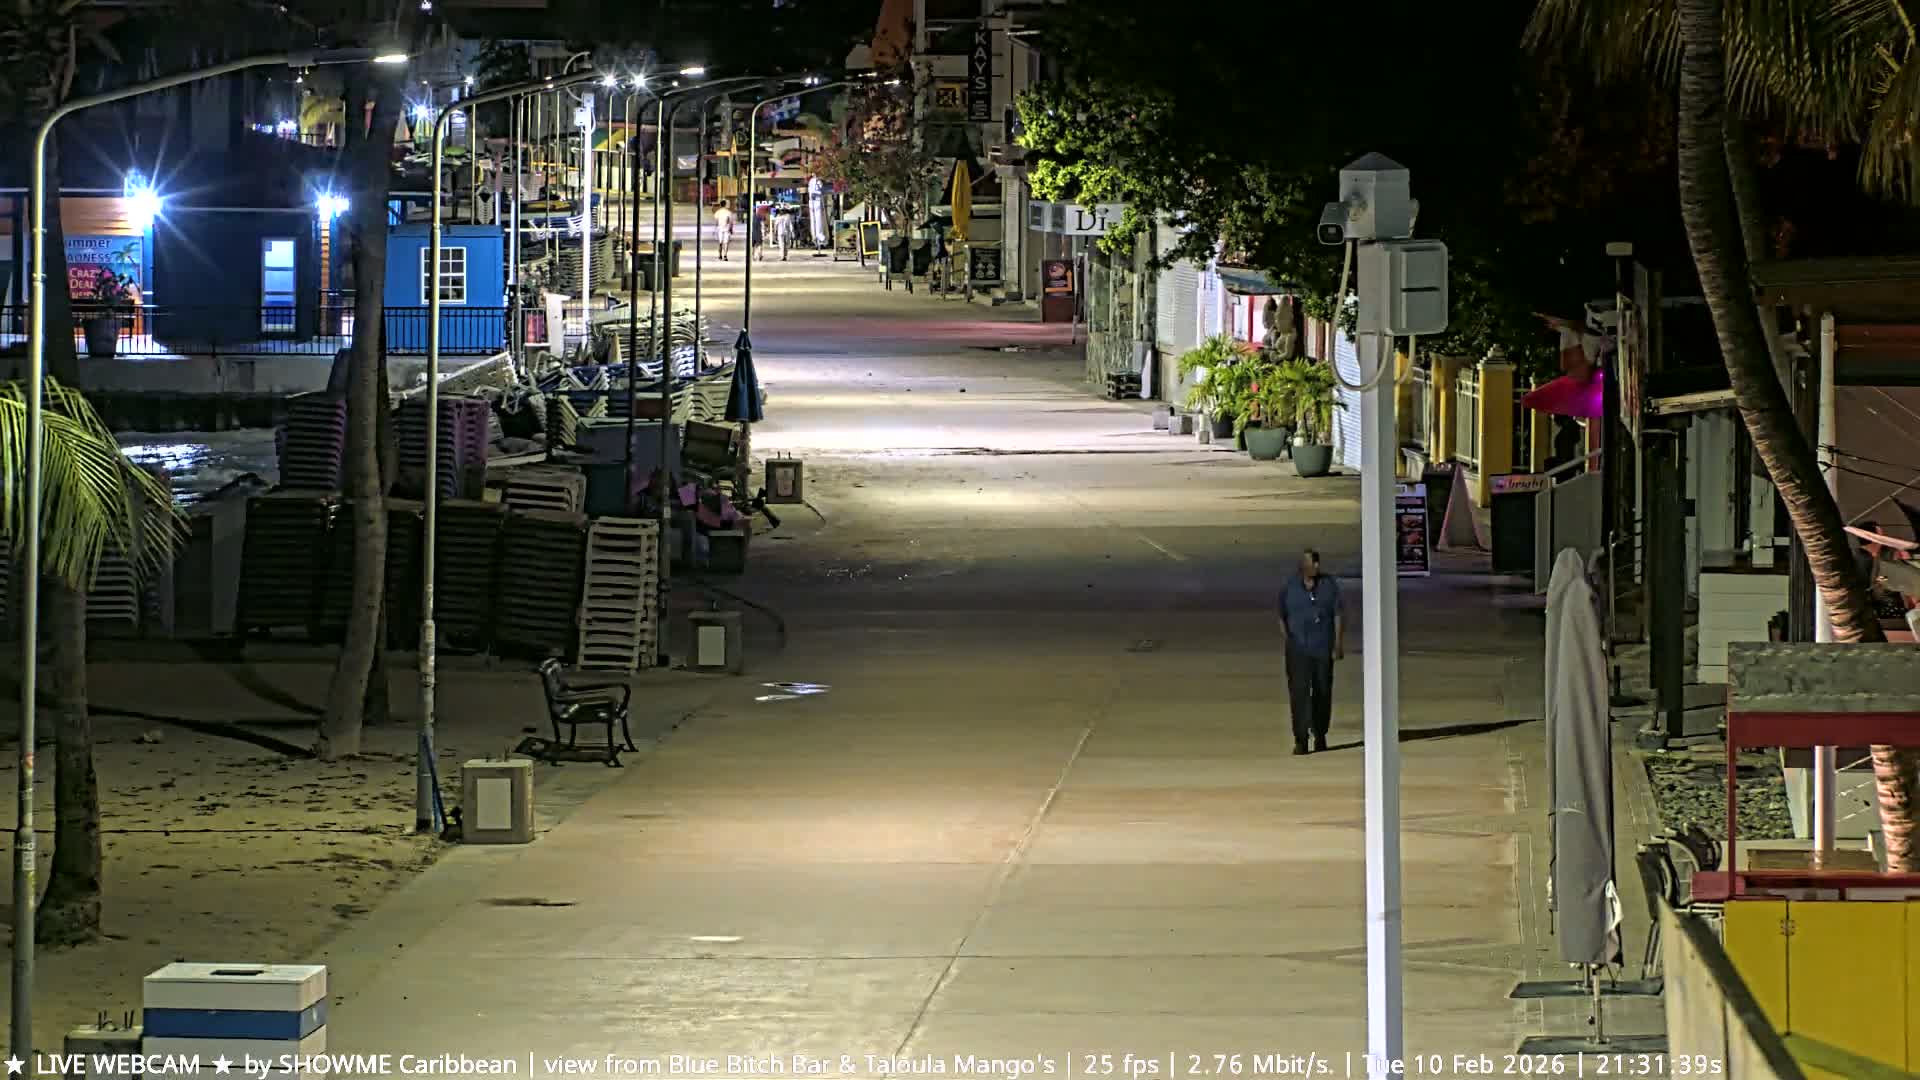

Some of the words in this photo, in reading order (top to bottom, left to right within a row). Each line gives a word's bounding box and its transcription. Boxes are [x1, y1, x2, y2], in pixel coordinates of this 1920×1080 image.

[1075, 208, 1110, 231] Di
[65, 239, 112, 249] ummer
[67, 253, 111, 264] ADNESS
